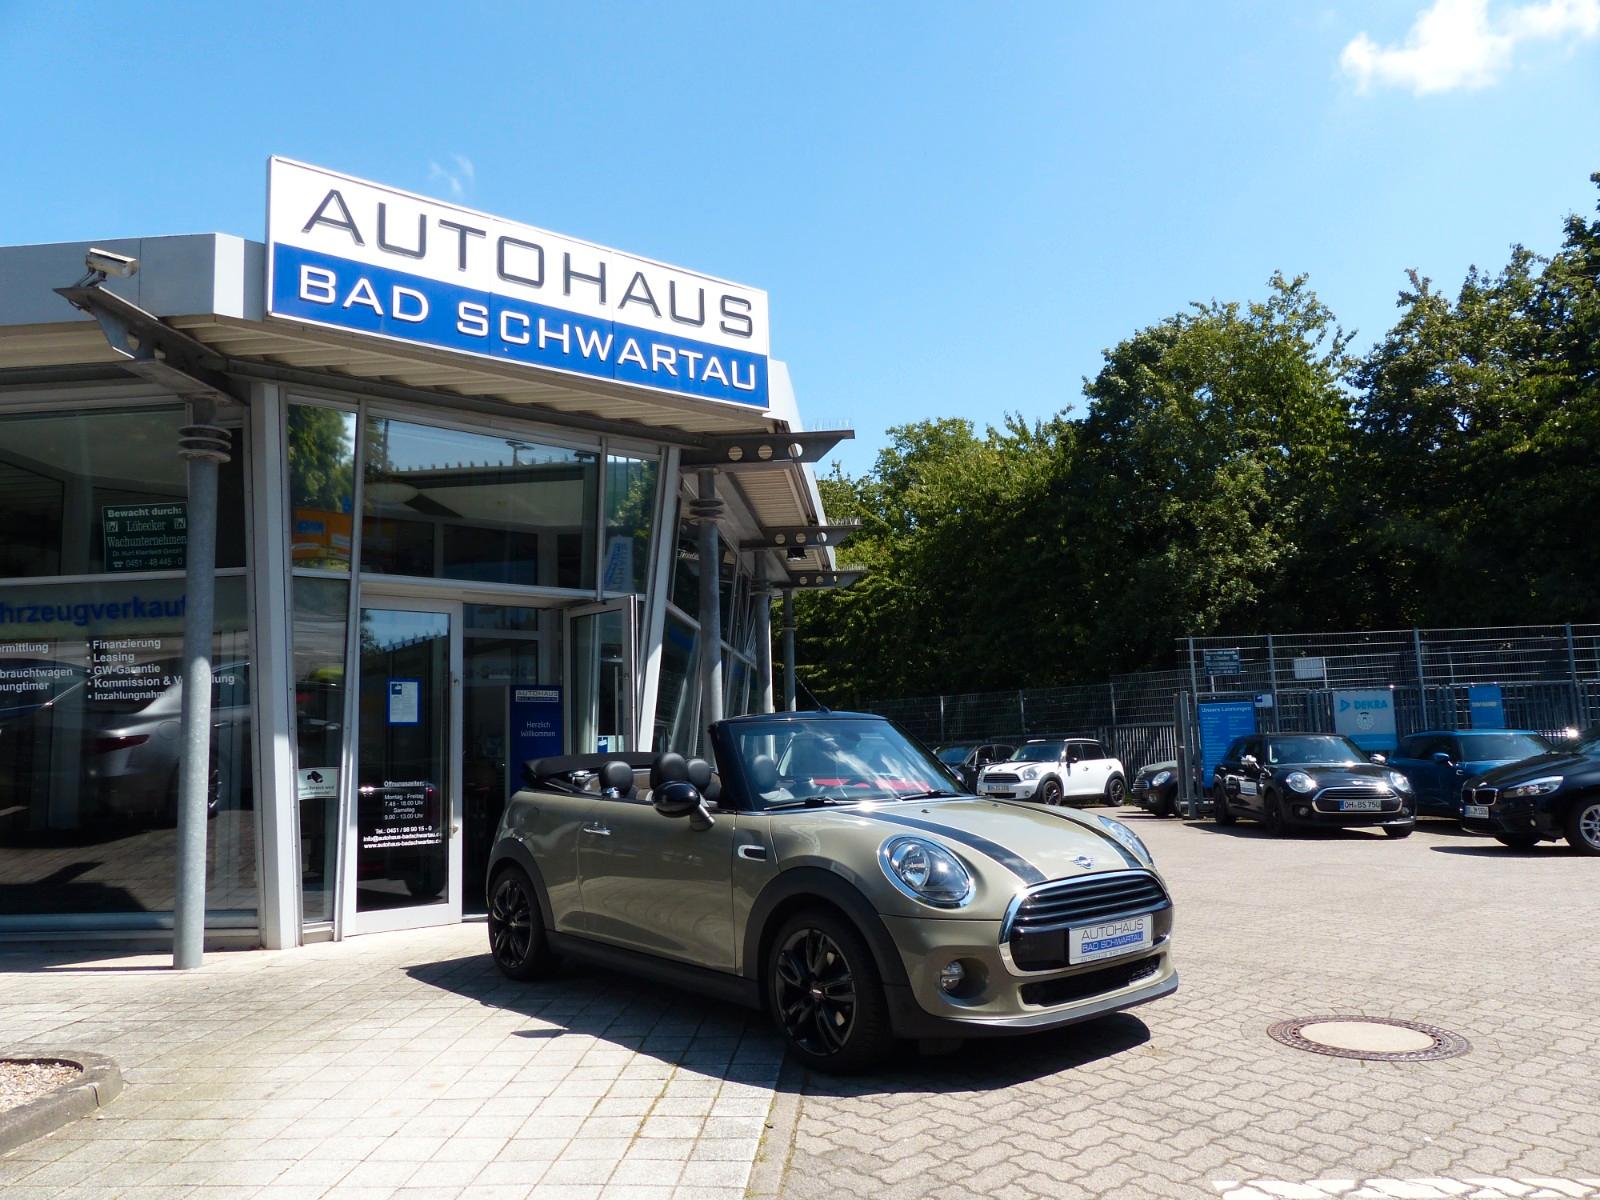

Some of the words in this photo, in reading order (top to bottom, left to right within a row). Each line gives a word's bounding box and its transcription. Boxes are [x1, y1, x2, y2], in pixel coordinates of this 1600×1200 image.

[301, 188, 754, 338] AUTOHAUS
[299, 264, 430, 323] BAD
[456, 301, 756, 391] SCHWARTAU
[107, 508, 149, 518] Bewacht
[151, 506, 182, 516] durch:
[0, 642, 49, 654] rmittlung
[93, 639, 161, 650] Finanzierung
[93, 653, 135, 663] Leasing
[0, 667, 73, 679] brauchtwagen
[93, 664, 160, 676] GW-Garantie
[94, 677, 160, 688] Kommission
[163, 676, 171, 686] &
[94, 690, 170, 701] Inzahlungnahm
[1353, 700, 1388, 710] DEKRA
[1081, 919, 1144, 941] AUTOHAUS
[1082, 942, 1099, 952] BAD
[1100, 932, 1144, 949] SCHWARTAU
